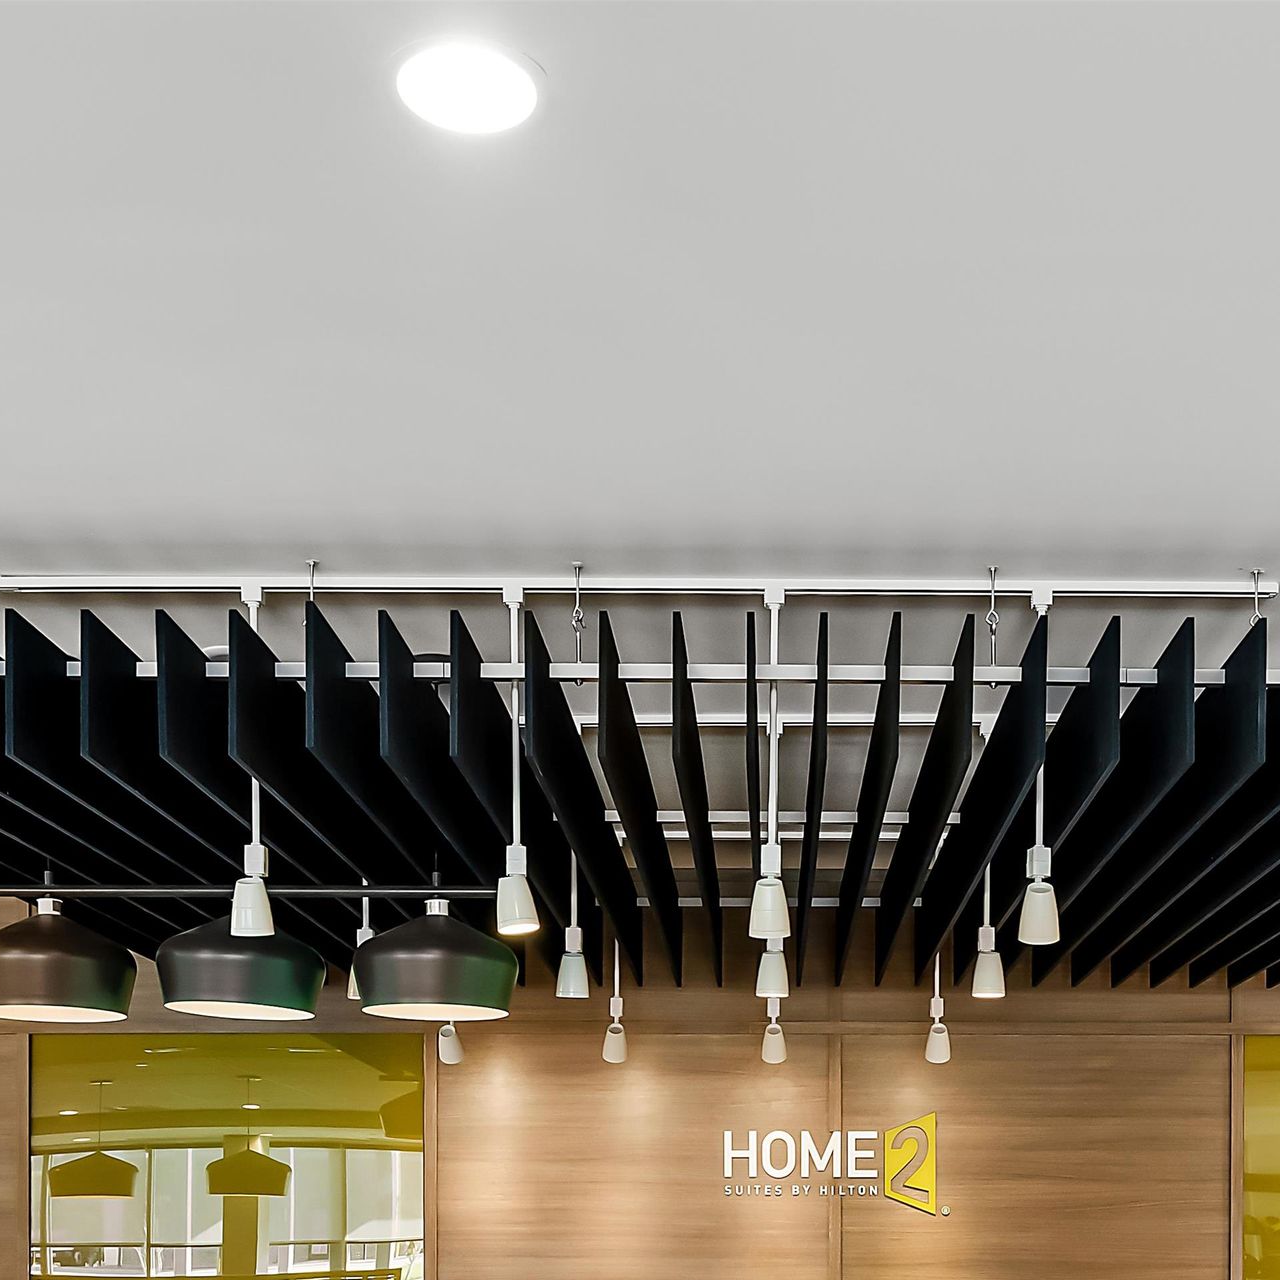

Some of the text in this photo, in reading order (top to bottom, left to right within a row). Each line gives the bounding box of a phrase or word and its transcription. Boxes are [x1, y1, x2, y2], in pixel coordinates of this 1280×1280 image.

[724, 1184, 878, 1196] SUITES BY HILTON
